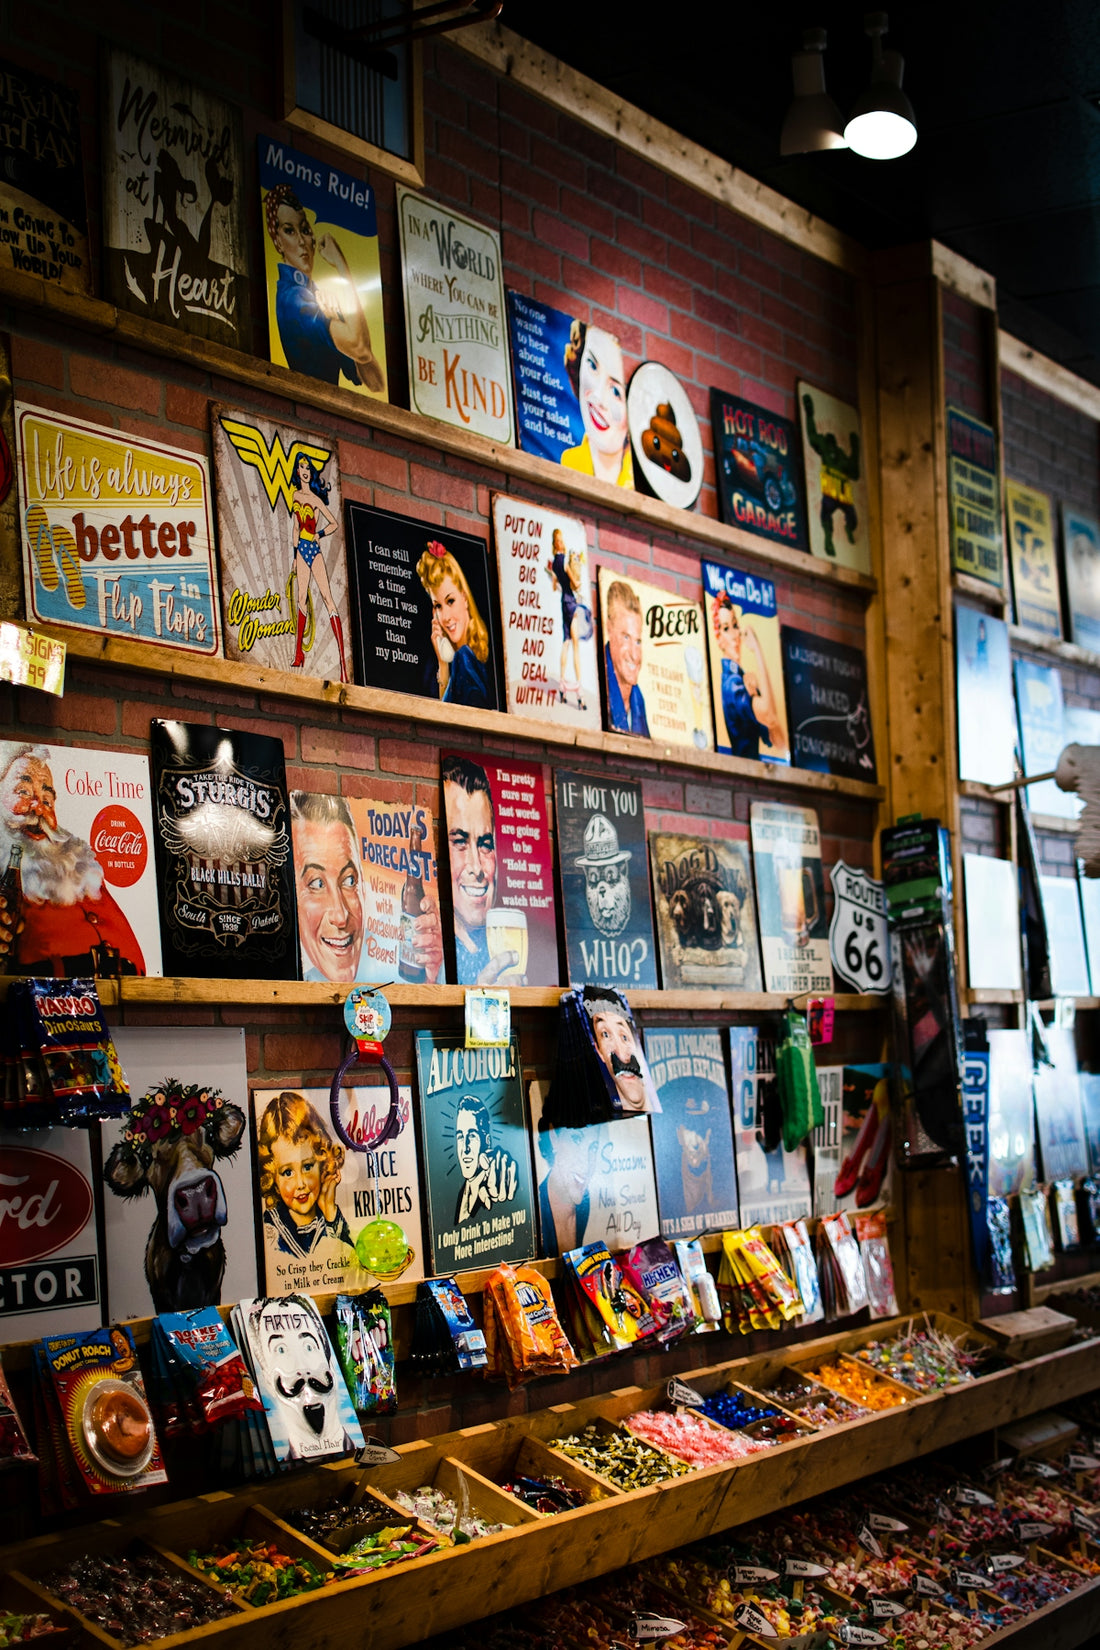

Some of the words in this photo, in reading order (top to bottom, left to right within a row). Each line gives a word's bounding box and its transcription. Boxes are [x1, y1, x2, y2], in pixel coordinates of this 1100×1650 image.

[117, 77, 230, 169] Mermaid
[266, 144, 321, 187] Moms
[328, 172, 370, 210] Rule!
[125, 174, 150, 206] at
[26, 234, 45, 254] UP
[408, 214, 420, 235] IN
[422, 223, 430, 240] A
[430, 220, 496, 282] WORLD
[10, 245, 63, 285] WORLD!
[152, 240, 236, 319] Heart
[411, 268, 445, 296] WHERE
[444, 274, 466, 305] YOU
[467, 294, 485, 314] CAN
[488, 304, 498, 319] BE
[514, 300, 529, 317] No
[532, 311, 546, 323] one
[416, 304, 498, 349] ANYTHING
[515, 318, 543, 336] wants
[517, 332, 528, 346] to
[530, 336, 549, 354] hear
[518, 348, 545, 368] about
[417, 356, 437, 386] BE
[443, 349, 506, 424] KIND
[520, 364, 540, 383] your
[542, 372, 564, 391] diet.
[521, 384, 540, 400] Just
[542, 394, 557, 408] eat
[523, 401, 542, 419] your
[545, 408, 569, 428] salad
[524, 419, 541, 433] and
[543, 423, 555, 437] be
[556, 428, 576, 446] sad.
[723, 404, 754, 436] HOT
[759, 413, 787, 455] ROD
[34, 429, 77, 500] Life
[80, 455, 103, 500] is
[107, 449, 194, 506] always
[504, 514, 525, 534] PUT
[528, 521, 542, 538] ON
[732, 492, 798, 540] GARAGE
[72, 512, 196, 562] better
[368, 541, 373, 553] I
[374, 545, 391, 558] can
[392, 548, 410, 563] still
[511, 540, 539, 562] YOUR
[369, 559, 412, 580] remember
[519, 565, 536, 584] BIG
[180, 575, 201, 599] in
[386, 579, 406, 595] time
[706, 564, 725, 591] We
[725, 571, 747, 600] Can
[746, 577, 762, 604] Do
[761, 582, 774, 608] It!
[95, 570, 143, 628] Flip
[147, 577, 208, 642] Flops
[228, 587, 281, 627] Wonder
[369, 594, 393, 609] when
[400, 602, 418, 614] was
[518, 589, 541, 610] GIRL
[377, 612, 412, 630] smarter
[509, 612, 553, 635] PANTIES
[646, 604, 699, 639] BEER
[239, 615, 296, 652] Woman
[386, 629, 406, 645] than
[25, 635, 64, 665] SIGNS
[375, 645, 391, 661] my
[392, 647, 419, 665] phone
[522, 638, 544, 657] AND
[522, 662, 548, 683] DEAL
[516, 686, 543, 706] WITH
[545, 689, 557, 707] IT
[65, 768, 103, 797] Coke
[105, 770, 144, 800] Time
[193, 774, 214, 782] TAKE
[228, 774, 244, 787] RIDE
[496, 769, 509, 783] I'm
[511, 771, 536, 789] pretty
[176, 777, 271, 818] STURGIS
[501, 790, 519, 802] sure
[520, 793, 534, 805] my
[562, 782, 578, 809] IF
[583, 785, 608, 810] NOT
[611, 788, 638, 817] YOU
[110, 820, 126, 828] DRINK
[367, 806, 428, 841] TODAY'S
[498, 804, 514, 818] last
[516, 807, 540, 822] words
[94, 829, 143, 855] Coca-Cola
[501, 824, 515, 836] are
[516, 826, 540, 842] going
[361, 836, 438, 881] FORECAST:
[512, 841, 521, 853] to
[522, 842, 532, 854] be
[114, 861, 135, 869] BOTTLES
[502, 858, 526, 873] "Hold
[528, 863, 541, 876] my
[190, 867, 215, 883] BLACK
[217, 869, 241, 886] HILLS
[242, 872, 266, 888] RALLY
[370, 874, 396, 895] Warm
[506, 876, 525, 889] beer
[526, 878, 543, 890] and
[502, 894, 525, 907] watch
[846, 877, 883, 910] ROUTE
[177, 903, 206, 924] South
[218, 914, 242, 924] SINCE
[376, 898, 393, 917] with
[251, 911, 280, 930] Dakota
[366, 917, 406, 943] occasional
[853, 911, 875, 932] US
[366, 934, 398, 966] Beers!
[579, 938, 648, 981] WHO?
[844, 931, 883, 982] 66
[36, 996, 96, 1017] HARIBO
[44, 1020, 102, 1035] Dinosaurs
[647, 1034, 677, 1065] NEVER
[427, 1045, 517, 1096] ALCOHOL!
[346, 1097, 410, 1150] Kello's
[963, 1059, 987, 1185] GEEK
[366, 1151, 398, 1178] RICE
[600, 1142, 647, 1174] Sarcasm:
[354, 1187, 412, 1218] KRISPIES
[442, 1230, 460, 1248] Only
[461, 1223, 481, 1244] Drink
[481, 1220, 491, 1236] To
[491, 1216, 511, 1234] Make
[511, 1209, 526, 1226] YOU
[606, 1213, 621, 1235] All
[623, 1210, 641, 1239] Day
[454, 1242, 473, 1261] More
[474, 1235, 514, 1256] Interesting!
[277, 1264, 286, 1276] So
[288, 1263, 307, 1276] Crisp
[309, 1260, 323, 1273] they
[326, 1256, 350, 1269] Crackle
[642, 1263, 679, 1289] HI-CHEW
[284, 1280, 292, 1290] in
[293, 1277, 310, 1289] Milk
[322, 1274, 344, 1286] Cream
[263, 1313, 309, 1331] ARTIST
[52, 1349, 80, 1372] DONUT
[82, 1344, 112, 1358] ROACH
[299, 1439, 322, 1453] Facial
[641, 1623, 670, 1633] Mimosa
